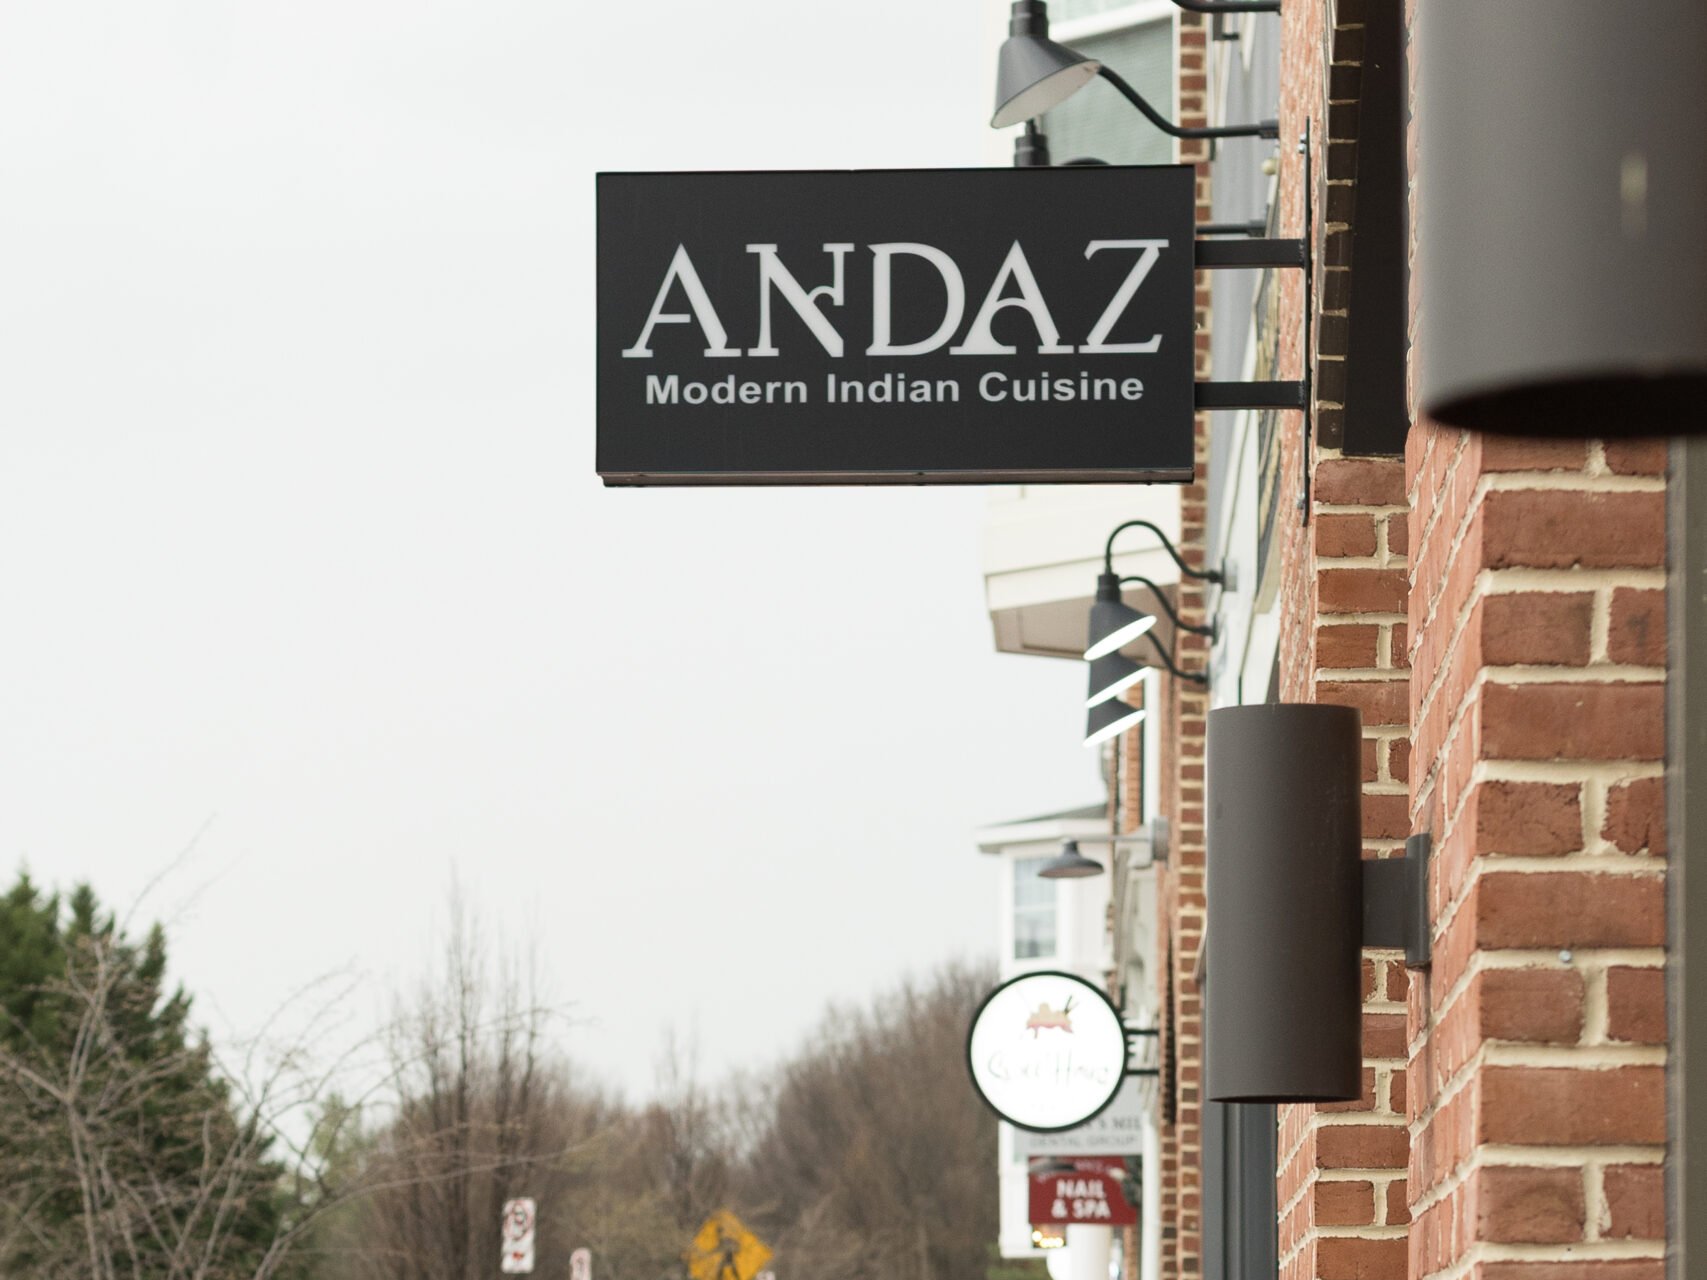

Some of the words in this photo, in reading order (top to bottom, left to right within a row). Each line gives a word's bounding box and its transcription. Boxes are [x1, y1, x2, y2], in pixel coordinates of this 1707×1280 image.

[621, 238, 1170, 358] ANDAZ
[645, 373, 808, 405] Modern
[826, 372, 960, 403] Indian
[977, 370, 1144, 402] Cuisine
[1056, 1178, 1107, 1200] NAIL
[1051, 1199, 1068, 1219] &
[1072, 1199, 1112, 1219] SPA
